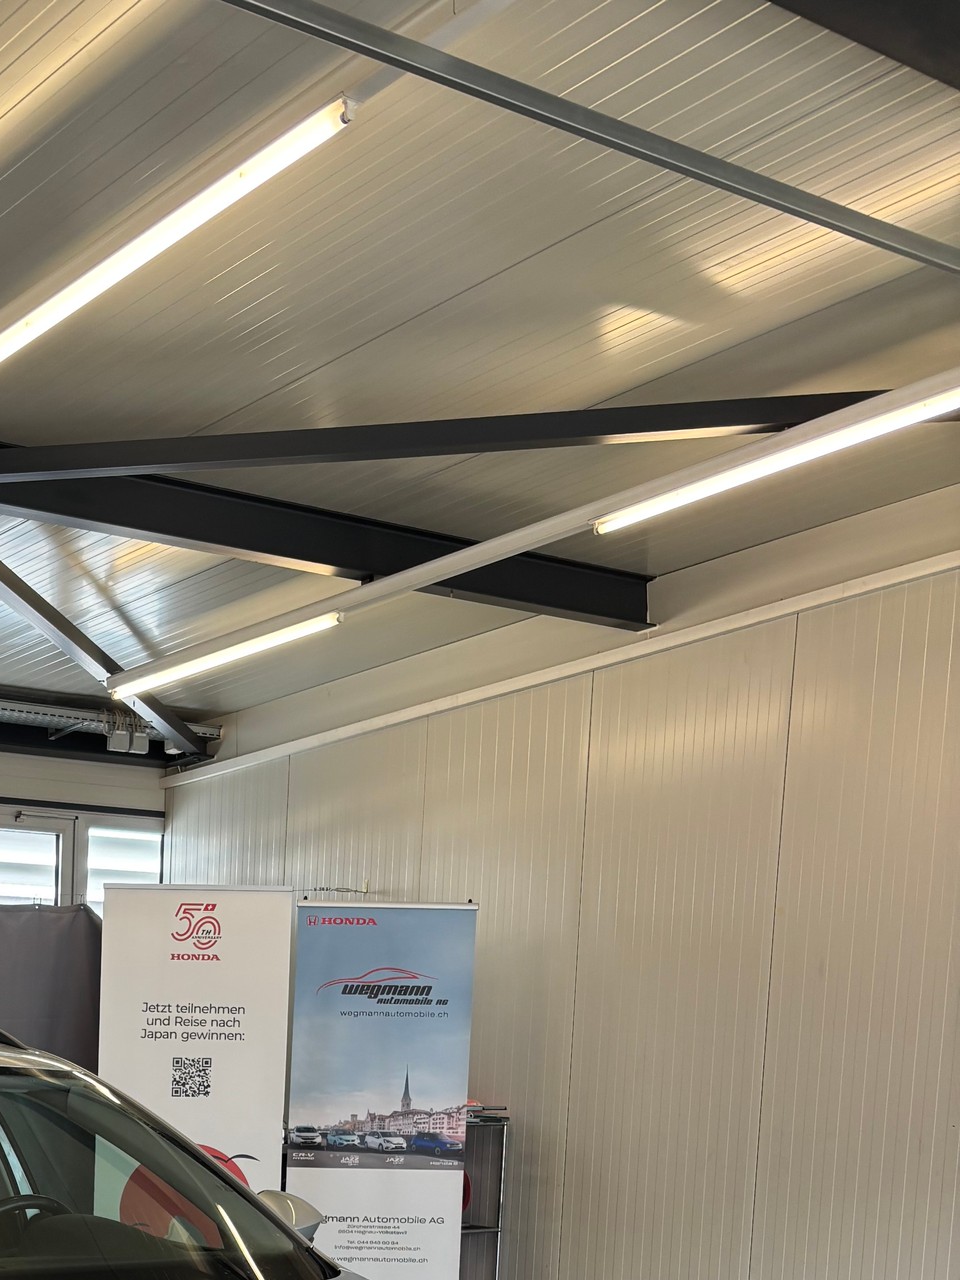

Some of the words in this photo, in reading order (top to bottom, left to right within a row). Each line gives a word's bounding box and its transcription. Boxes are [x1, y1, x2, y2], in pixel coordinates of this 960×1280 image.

[321, 917, 377, 926] HONDA
[170, 953, 221, 961] HONDA
[341, 984, 432, 999] wegmann
[141, 1002, 172, 1013] Jetzt
[176, 1003, 246, 1015] teilnehmen
[340, 1010, 449, 1019] wegmannautomobile.ch
[146, 1016, 171, 1026] und
[174, 1016, 207, 1027] Reise
[211, 1017, 241, 1028] nach
[140, 1028, 178, 1041] Japan
[181, 1030, 246, 1042] gewinnen:
[321, 1215, 359, 1224] gmann
[362, 1215, 426, 1224] Automobile
